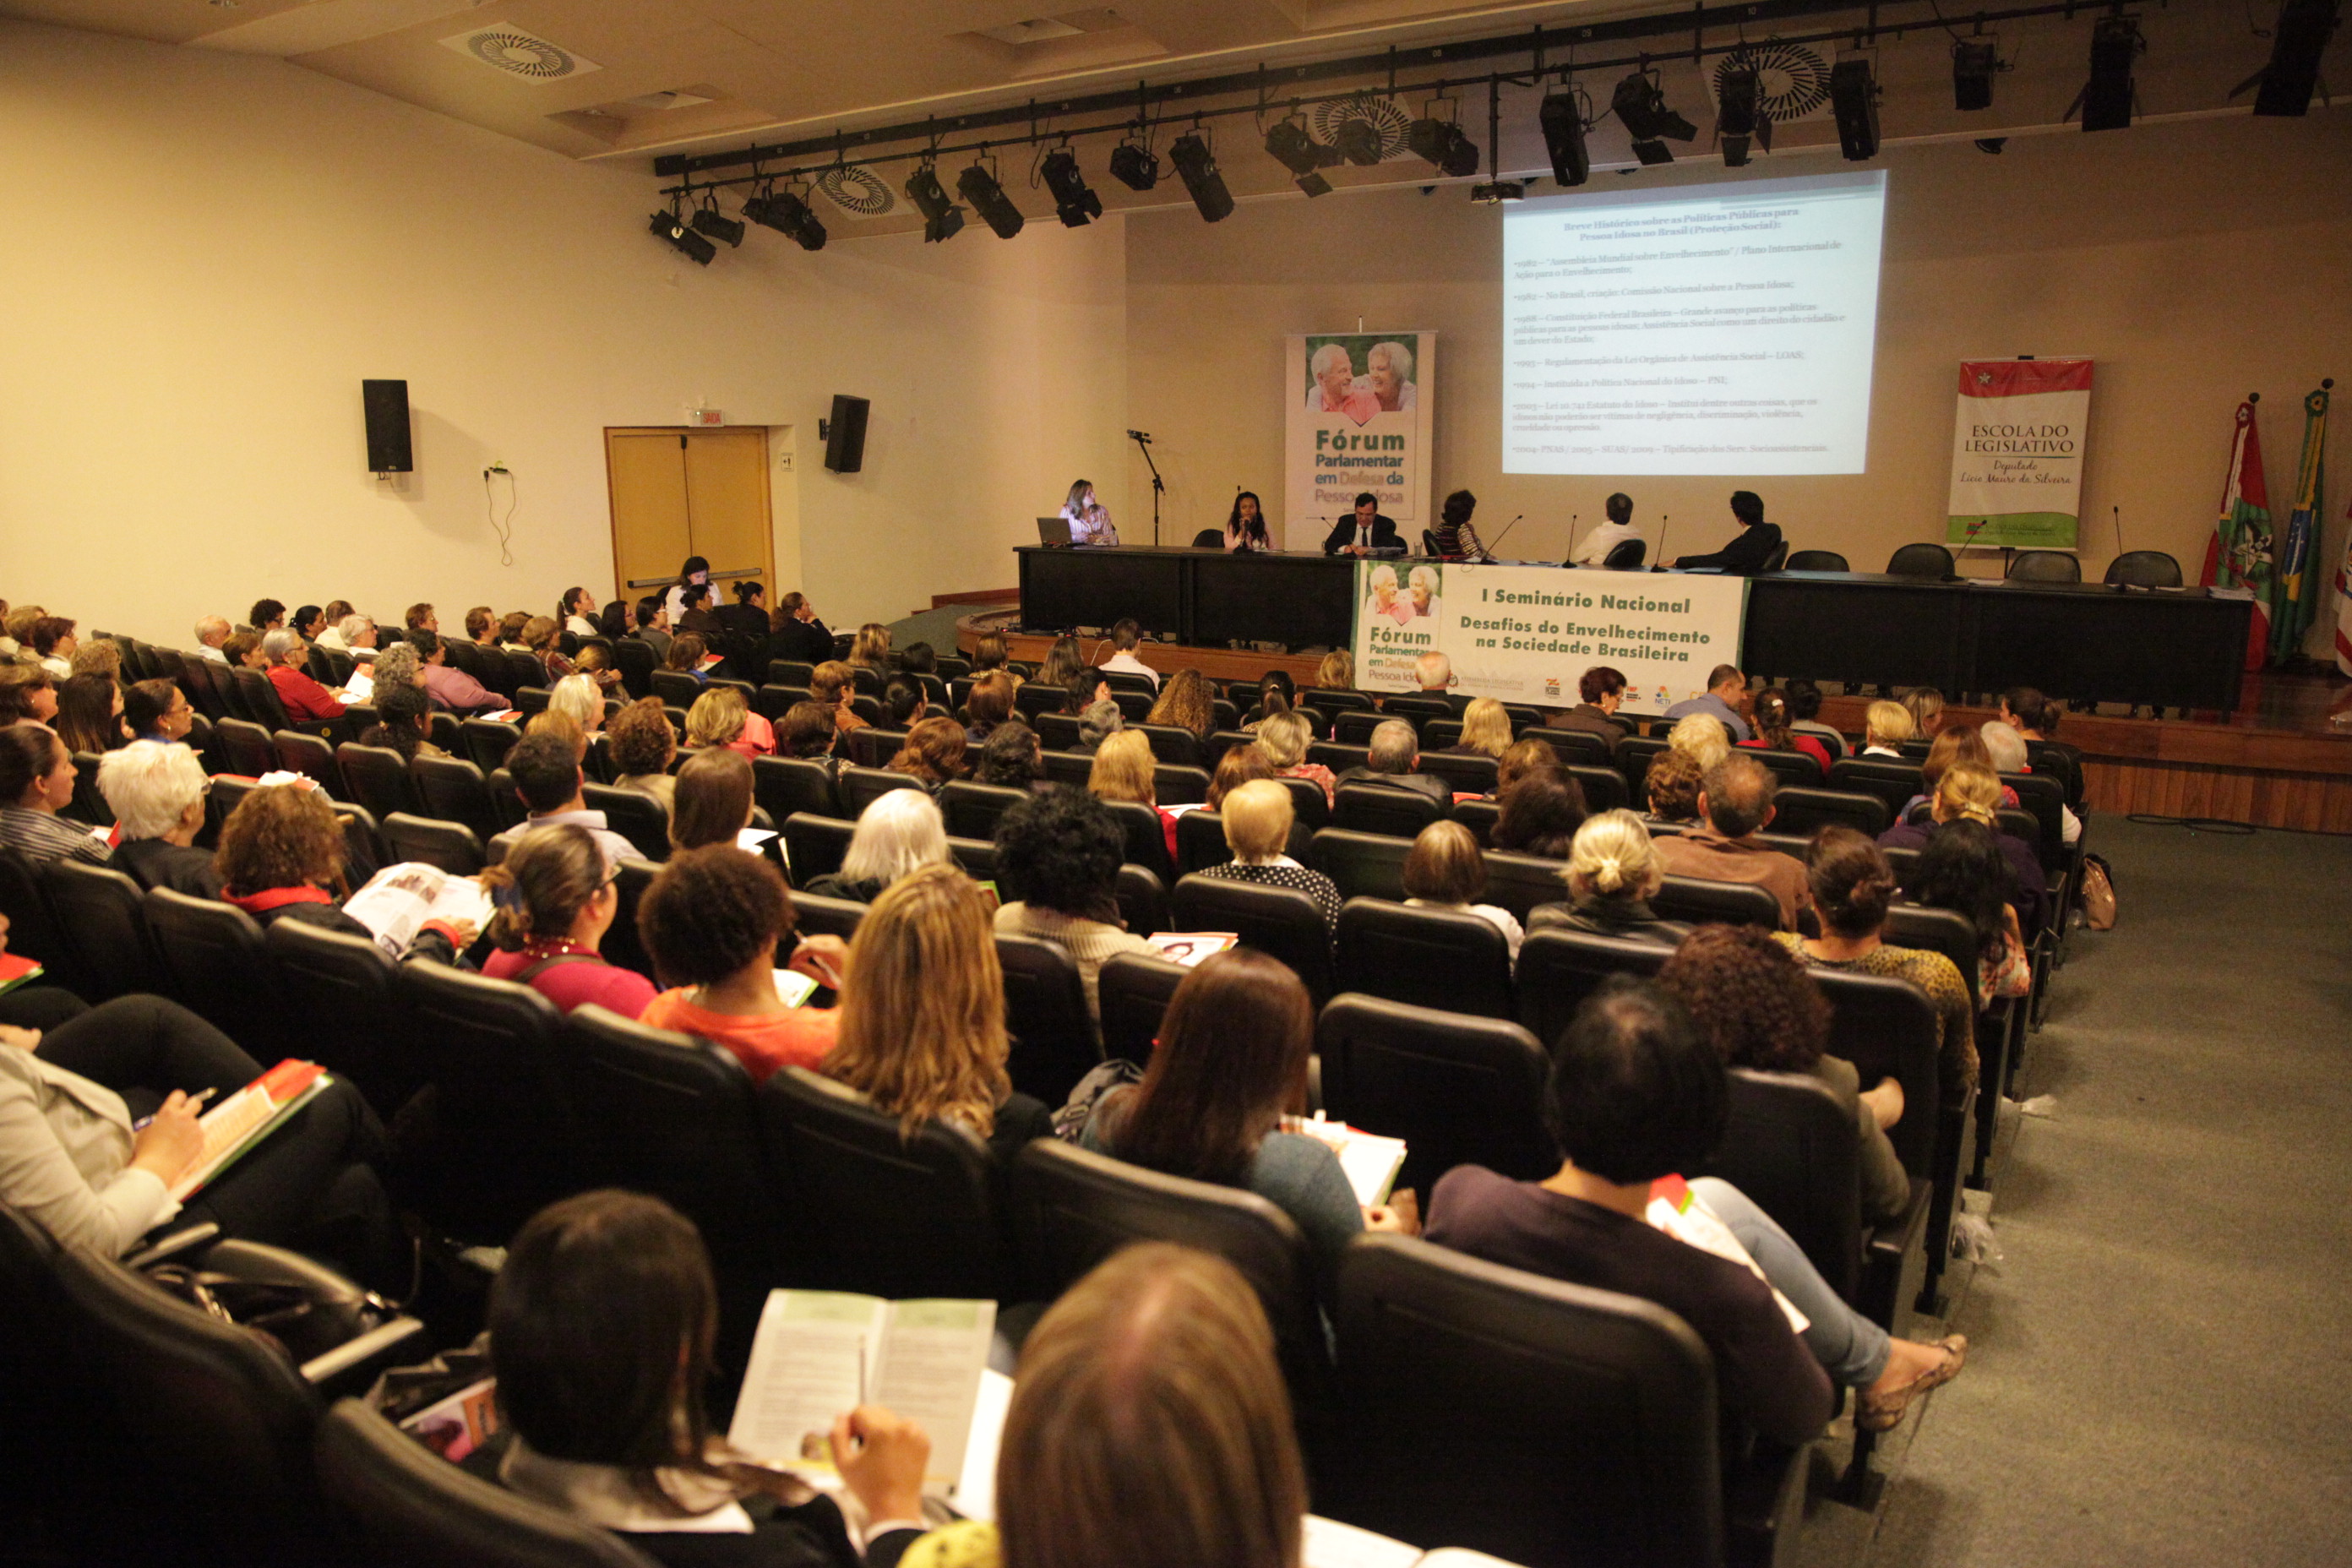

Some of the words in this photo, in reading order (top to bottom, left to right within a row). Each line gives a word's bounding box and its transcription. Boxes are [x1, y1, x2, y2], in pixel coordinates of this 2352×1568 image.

[1593, 219, 1640, 228] Histórico
[1641, 216, 1669, 226] sobre
[1684, 213, 1727, 223] Políticas
[1729, 210, 1772, 220] Públicas
[1774, 210, 1798, 218] para
[1614, 230, 1641, 238] Idosa
[1658, 226, 1688, 235] Brasil
[1598, 253, 1634, 263] Mundial
[1635, 252, 1658, 260] sobre
[1742, 246, 1767, 255] Plano
[1768, 242, 1828, 253] Internacional
[1830, 240, 1842, 249] de
[1514, 272, 1534, 280] Ação
[1535, 271, 1554, 280] para
[1622, 286, 1663, 296] Comissão
[1663, 284, 1701, 294] Nacional
[1702, 284, 1727, 292] sobre
[1735, 282, 1764, 291] Pessoa
[1545, 313, 1597, 323] Constituição
[1598, 310, 1631, 319] Federal
[1631, 309, 1672, 318] Brasileira
[1681, 306, 1712, 316] Grande
[1713, 308, 1744, 316] avanço
[1745, 306, 1766, 315] para
[1779, 302, 1816, 314] políticas
[1548, 326, 1566, 335] para
[1578, 324, 1610, 333] pessoas
[1642, 319, 1688, 329] Assistência
[1690, 318, 1715, 327] Social
[1758, 316, 1788, 324] direito
[1789, 315, 1801, 324] do
[1803, 313, 1838, 323] cidadão
[1527, 336, 1551, 345] dever
[1544, 357, 1612, 368] Regulamentação
[1690, 353, 1738, 362] Assistência
[1740, 351, 1766, 360] Social
[1624, 377, 1661, 387] Nacional
[1662, 377, 1673, 385] do
[1674, 376, 1698, 385] Idoso
[1546, 401, 1558, 410] Lei
[1587, 400, 1621, 409] Estatuto
[1622, 400, 1634, 409] do
[1636, 400, 1658, 409] Idoso
[1700, 399, 1729, 407] dentre
[1729, 399, 1757, 407] outras
[1789, 399, 1805, 408] que
[1512, 412, 1538, 421] idosos
[1539, 412, 1553, 421] não
[1554, 412, 1588, 422] poderão
[1973, 424, 2035, 438] ESCOLA
[2041, 425, 2069, 438] DO
[1316, 429, 1404, 450] Fórum
[1965, 440, 2074, 453] LEGISLATIVO
[1710, 444, 1725, 453] dos
[1316, 454, 1404, 467] Parlamentar
[1994, 460, 2038, 475] Deputado
[1315, 474, 1337, 485] em
[1340, 471, 1384, 485] Defesa
[1386, 471, 1404, 485] da
[1987, 473, 2016, 483] Mauro
[2019, 473, 2031, 483] da
[2034, 473, 2072, 483] Silveira
[1315, 488, 1358, 502] Pesso
[1482, 588, 1488, 602] I
[1495, 589, 1593, 608] Seminário
[1601, 595, 1690, 613] Nacional
[1370, 627, 1431, 645] Fórum
[1461, 616, 1533, 633] Desafios
[1538, 620, 1560, 634] do
[1566, 622, 1710, 644] Envelhecimento
[1476, 638, 1496, 648] na
[1502, 636, 1592, 655] Sociedade
[1598, 642, 1689, 662] Brasileira
[1386, 657, 1416, 669] Defesa
[1369, 669, 1401, 681] Pessoa
